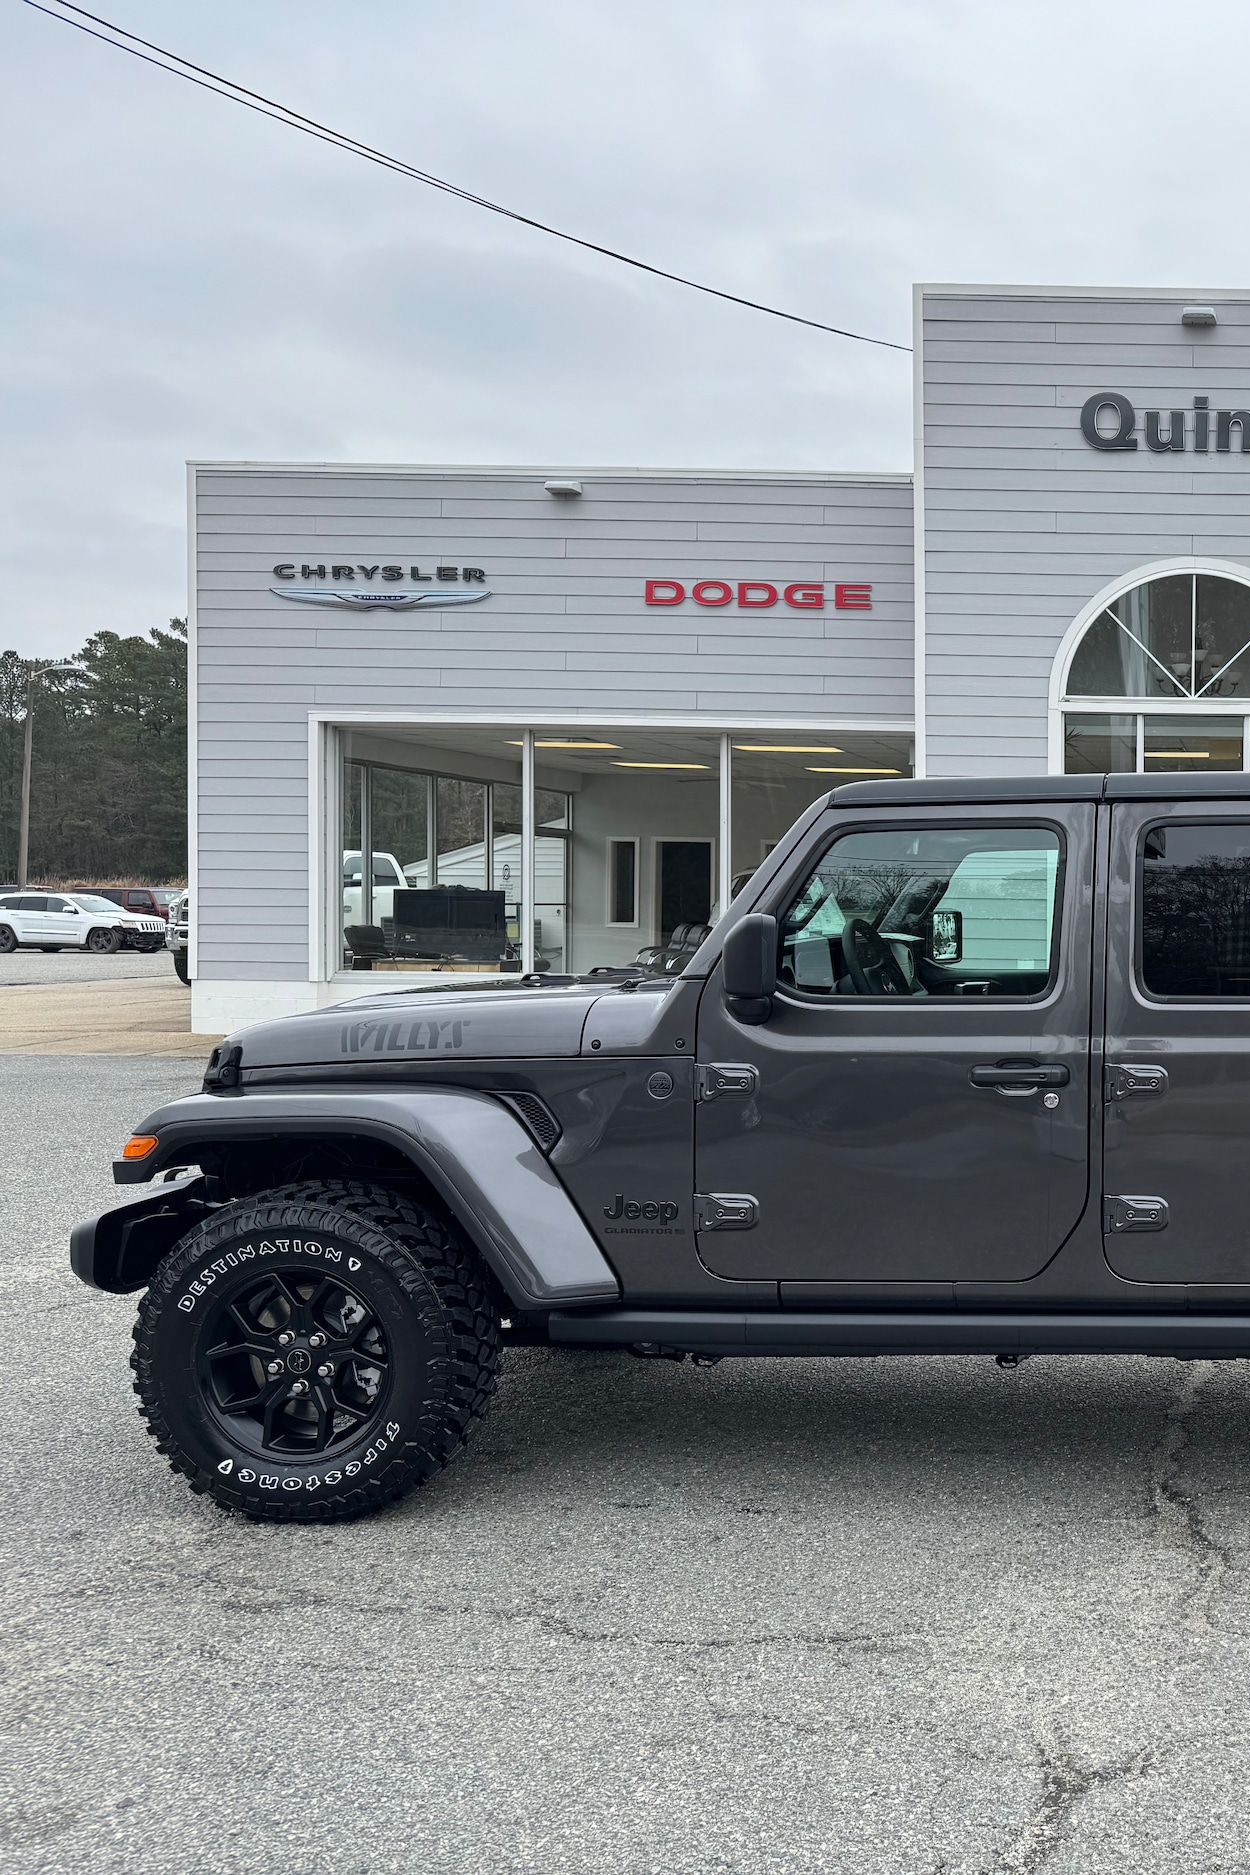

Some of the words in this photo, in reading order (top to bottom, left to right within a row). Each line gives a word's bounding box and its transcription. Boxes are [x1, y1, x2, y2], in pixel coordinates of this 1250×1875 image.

[272, 563, 486, 582] CHRYSLER
[645, 579, 872, 609] DODGE
[341, 1020, 471, 1053] WILLYS
[603, 1193, 679, 1226] Jeep
[604, 1227, 673, 1235] GLADIATOR
[177, 1239, 343, 1313] DESTINATION
